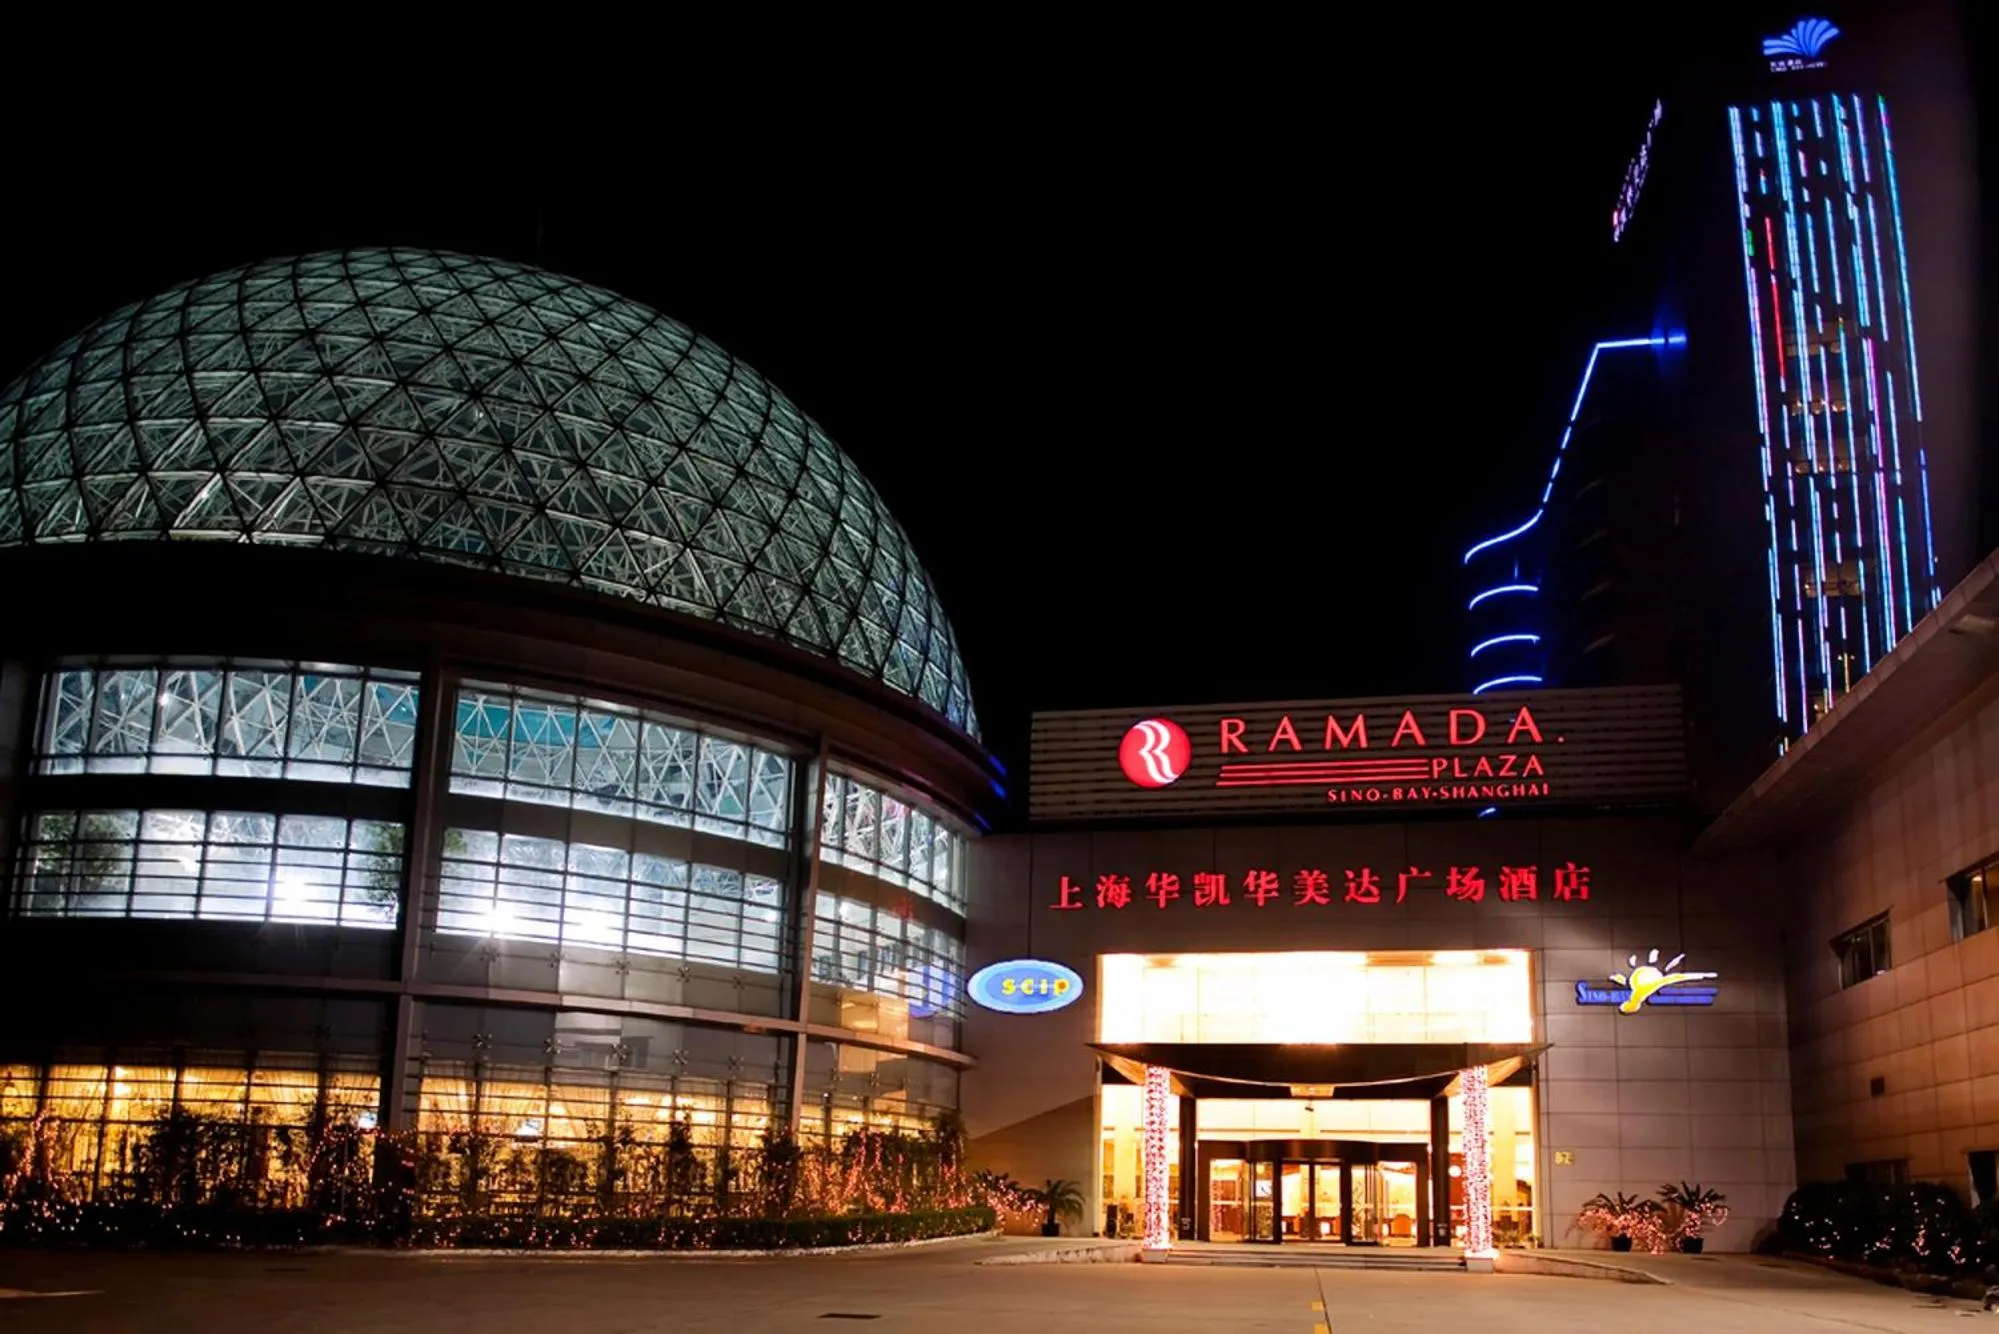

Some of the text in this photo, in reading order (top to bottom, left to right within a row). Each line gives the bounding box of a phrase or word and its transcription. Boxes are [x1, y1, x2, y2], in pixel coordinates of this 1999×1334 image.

[1431, 754, 1544, 779] PLAZA
[1049, 861, 1592, 909] 上海华凯华美达广场酒店
